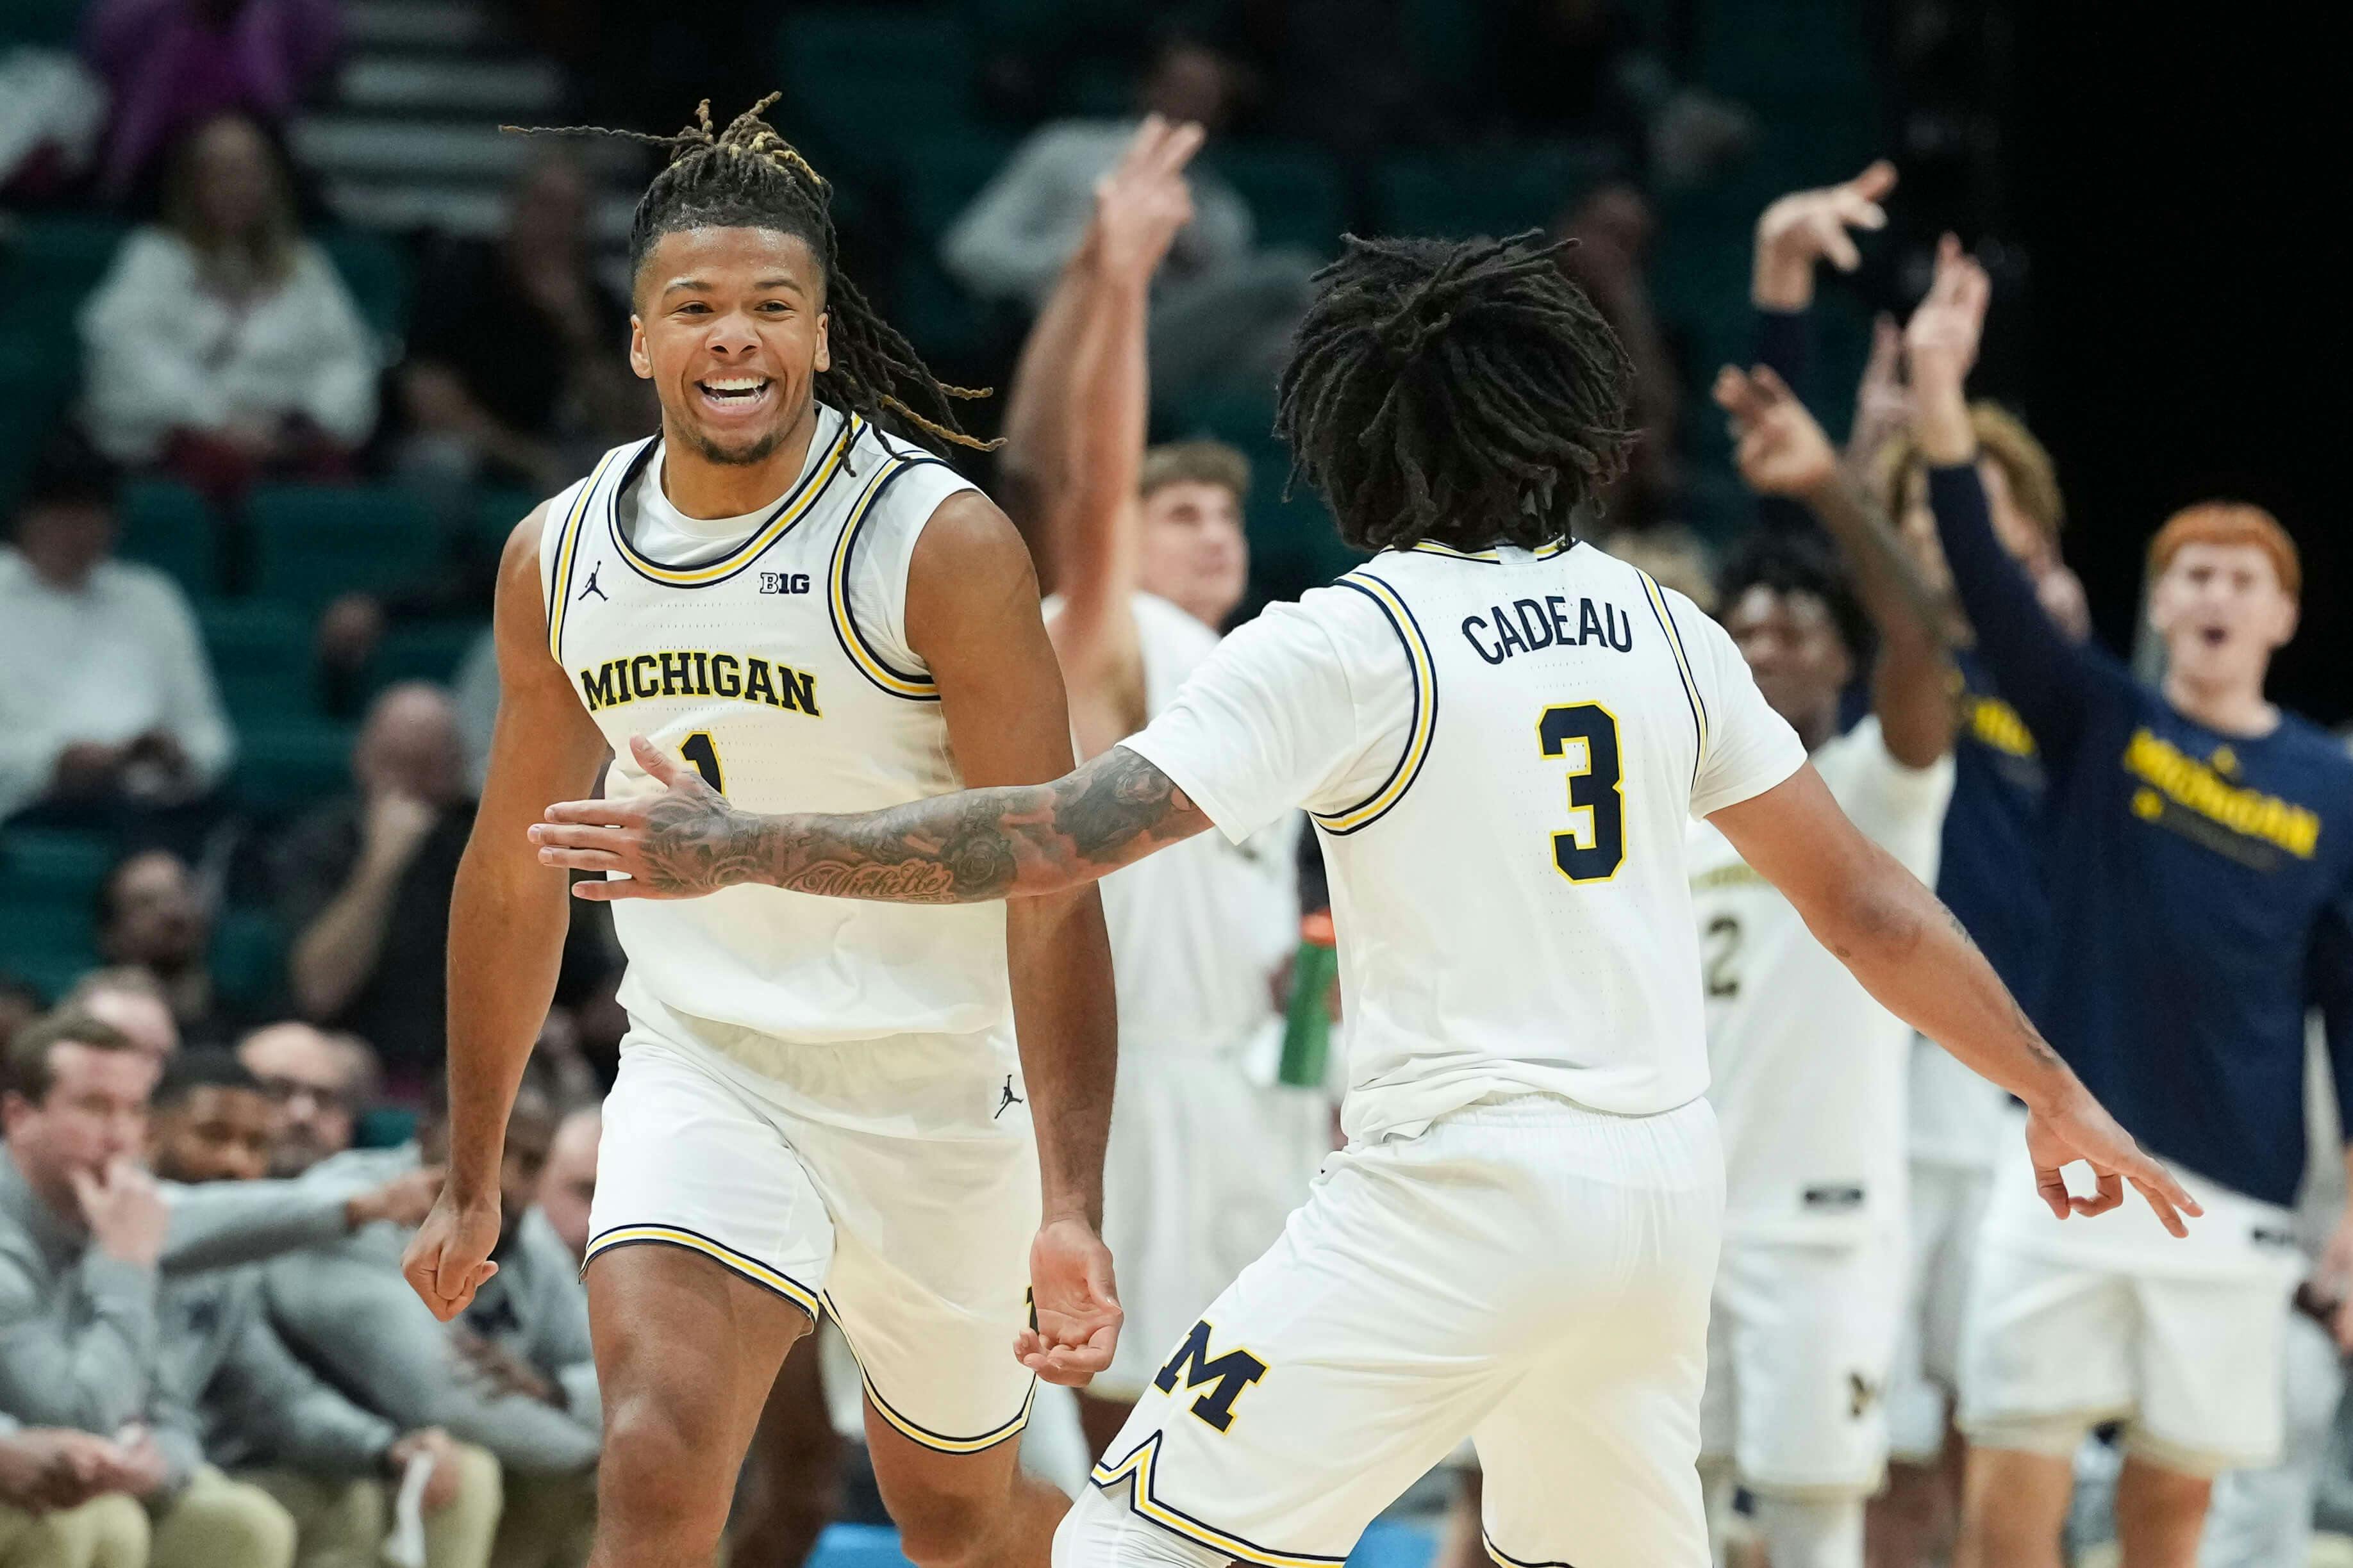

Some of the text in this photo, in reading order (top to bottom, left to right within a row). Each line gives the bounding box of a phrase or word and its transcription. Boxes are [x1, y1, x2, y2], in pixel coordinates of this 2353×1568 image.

[1461, 596, 1633, 665] CADEAU
[580, 652, 823, 719] MICHIGAN
[1535, 700, 1627, 886] 3
[1153, 1318, 1271, 1435] M
